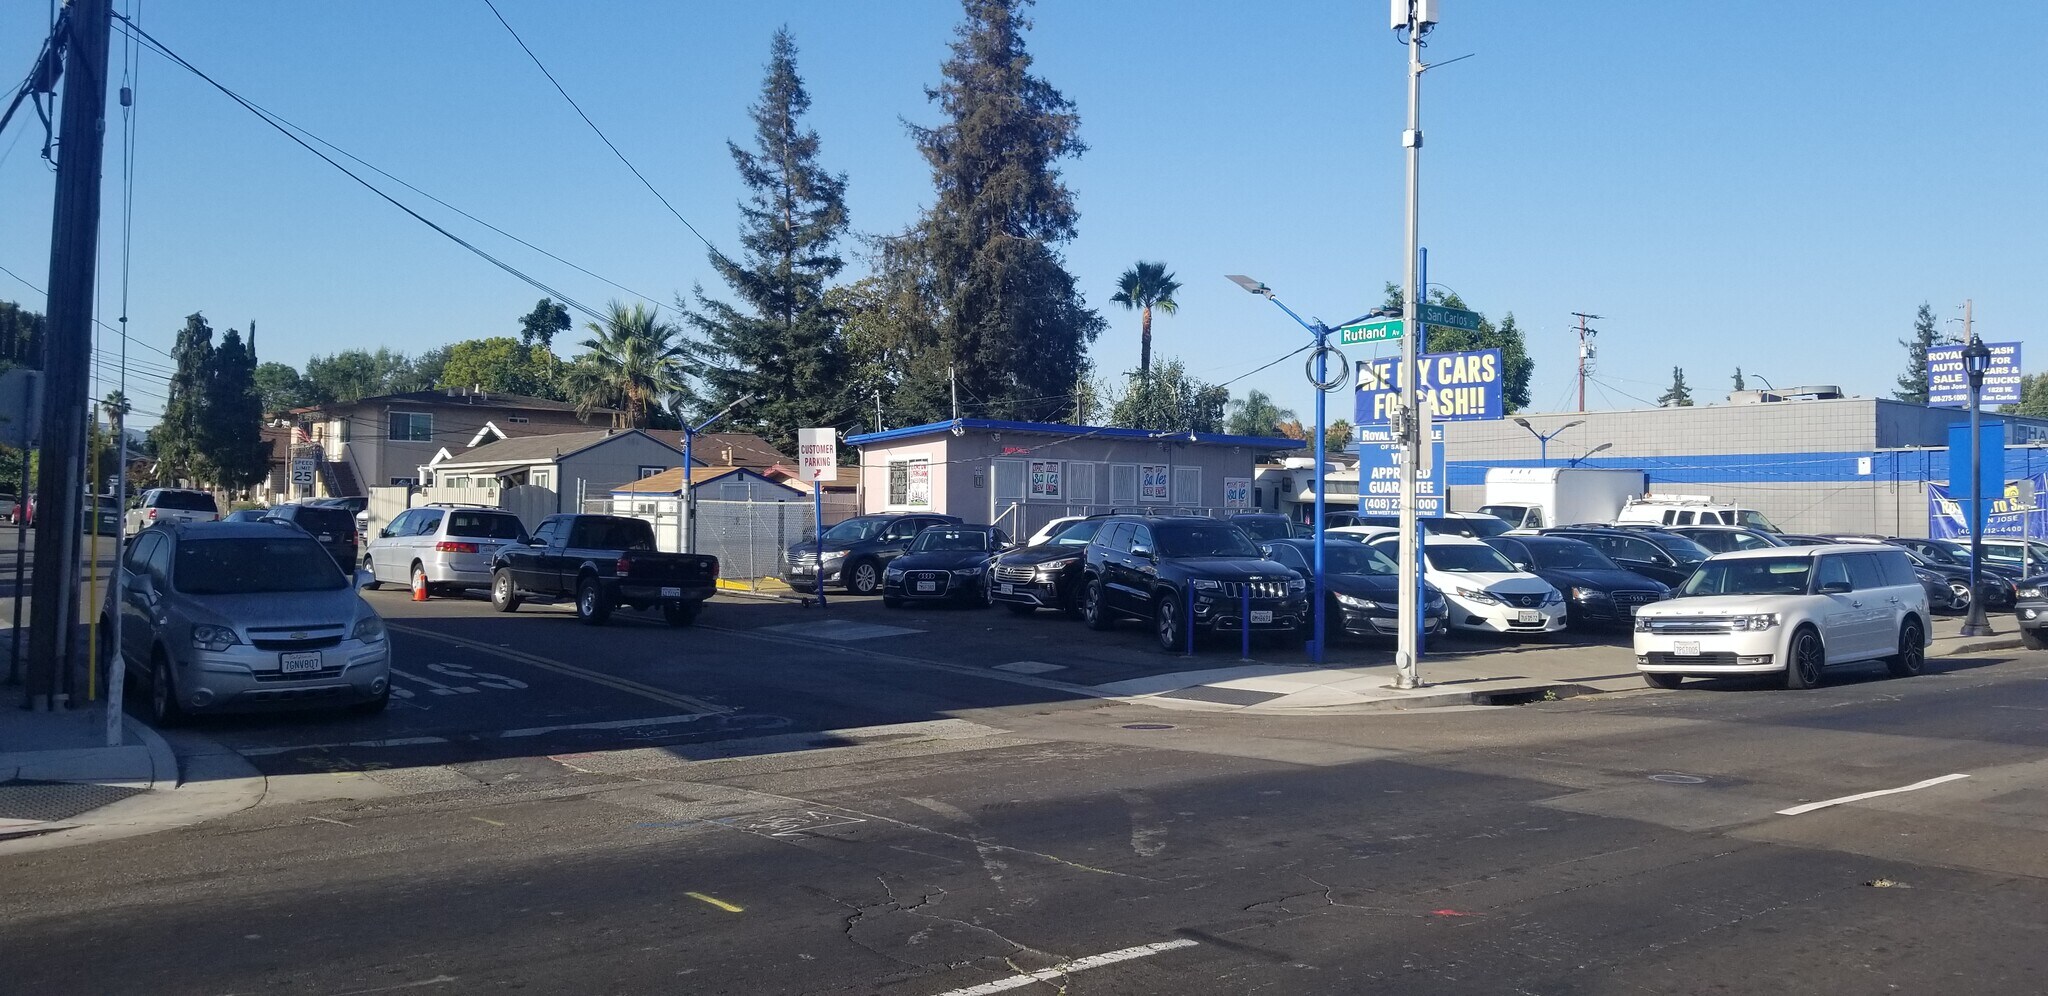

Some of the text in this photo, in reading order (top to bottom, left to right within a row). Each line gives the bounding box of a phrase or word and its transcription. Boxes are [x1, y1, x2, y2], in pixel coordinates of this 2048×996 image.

[1427, 309, 1442, 322] San
[1443, 311, 1467, 326] Carlos
[1343, 326, 1387, 342] Rutland
[1990, 356, 2011, 365] FOR
[1438, 353, 1496, 385] CARS
[1931, 362, 1964, 373] AUTO
[2011, 366, 2019, 374] &
[1933, 373, 1963, 384] SALE
[1982, 376, 2020, 385] TRUCKS
[1362, 430, 1390, 441] ROYAL
[801, 444, 834, 455] CUSTOMER
[804, 457, 831, 467] PARKING
[293, 471, 312, 482] 25
[1364, 498, 1390, 511] (408)
[1997, 514, 2018, 523] JOSE
